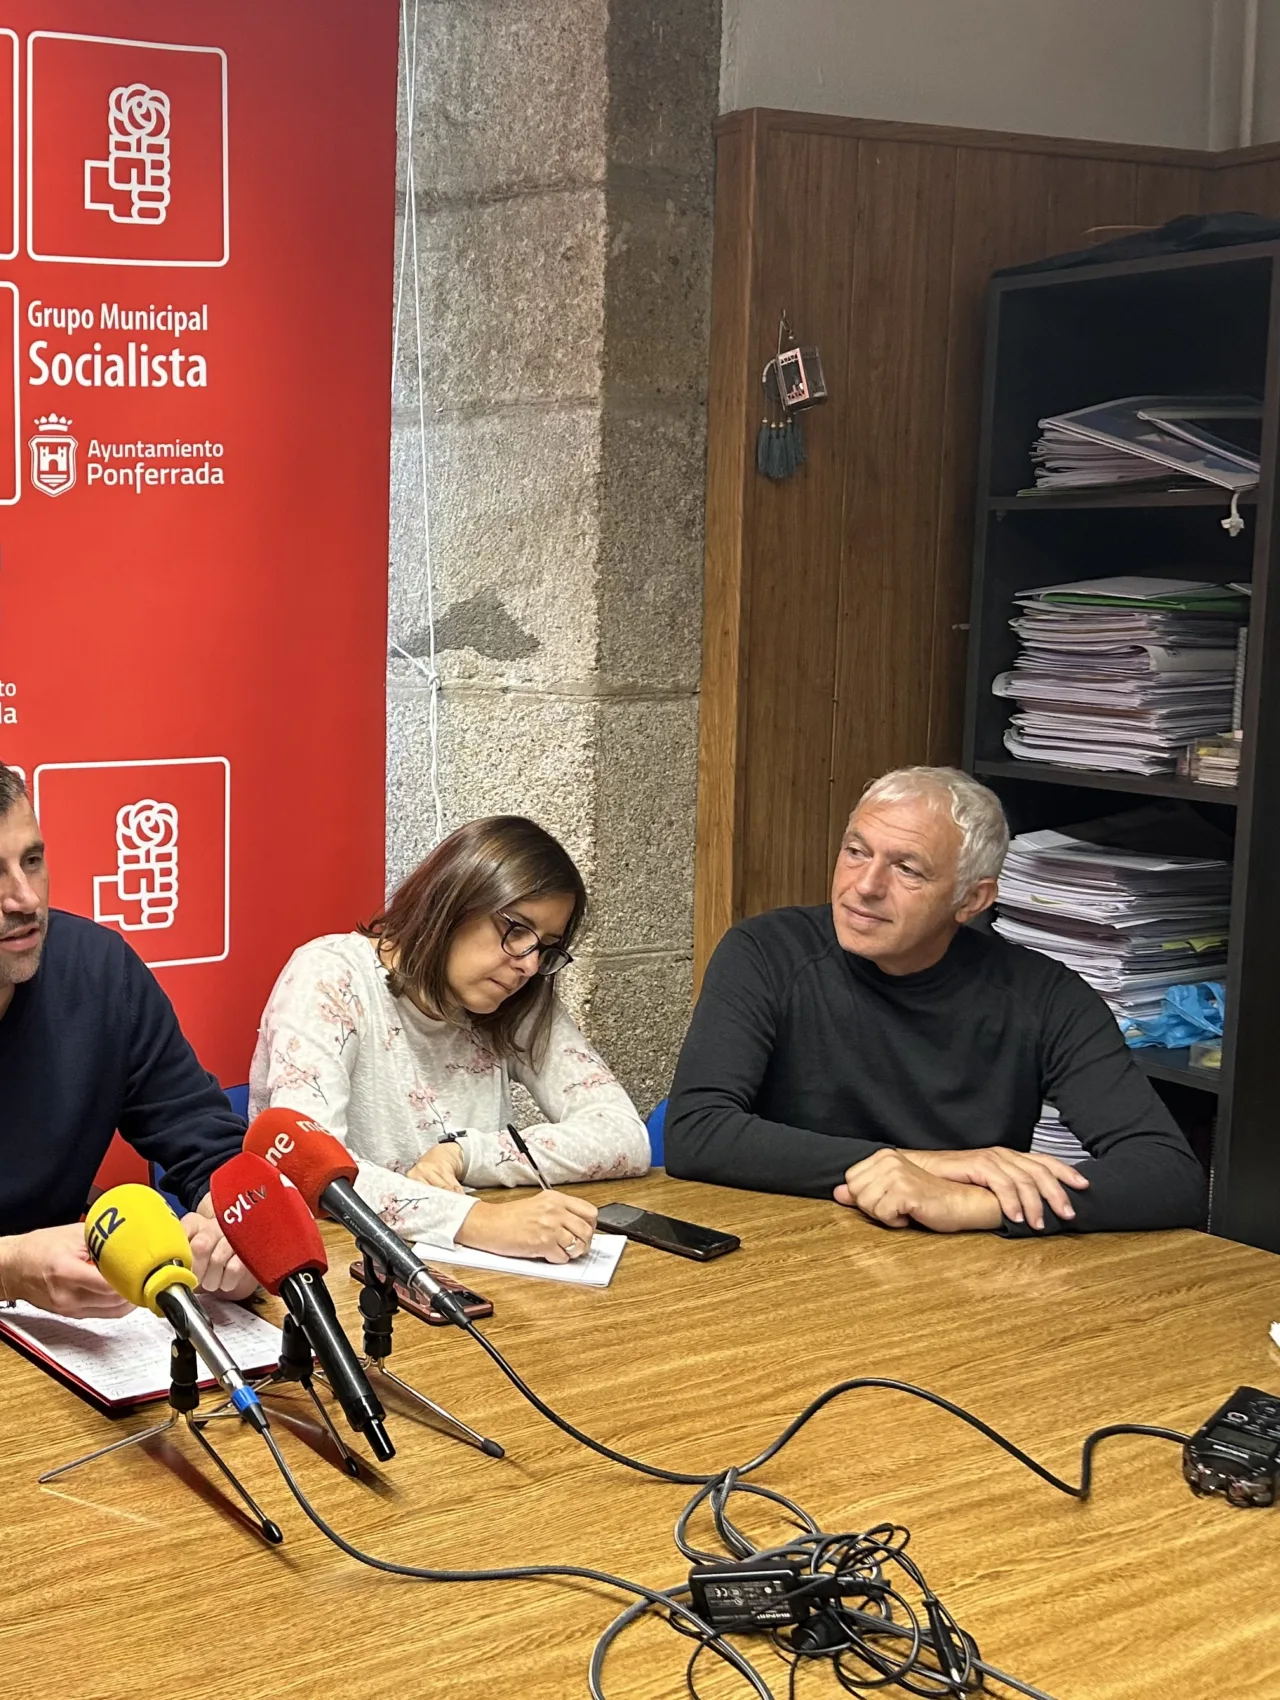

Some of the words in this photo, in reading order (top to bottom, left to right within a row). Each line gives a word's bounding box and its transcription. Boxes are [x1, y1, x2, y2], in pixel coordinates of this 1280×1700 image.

[27, 300, 95, 332] Grupo
[100, 302, 209, 337] Municipal
[28, 340, 209, 388] Socialista
[87, 439, 225, 463] Ayuntamiento
[86, 461, 226, 495] Ponferrada
[264, 1132, 295, 1167] ne
